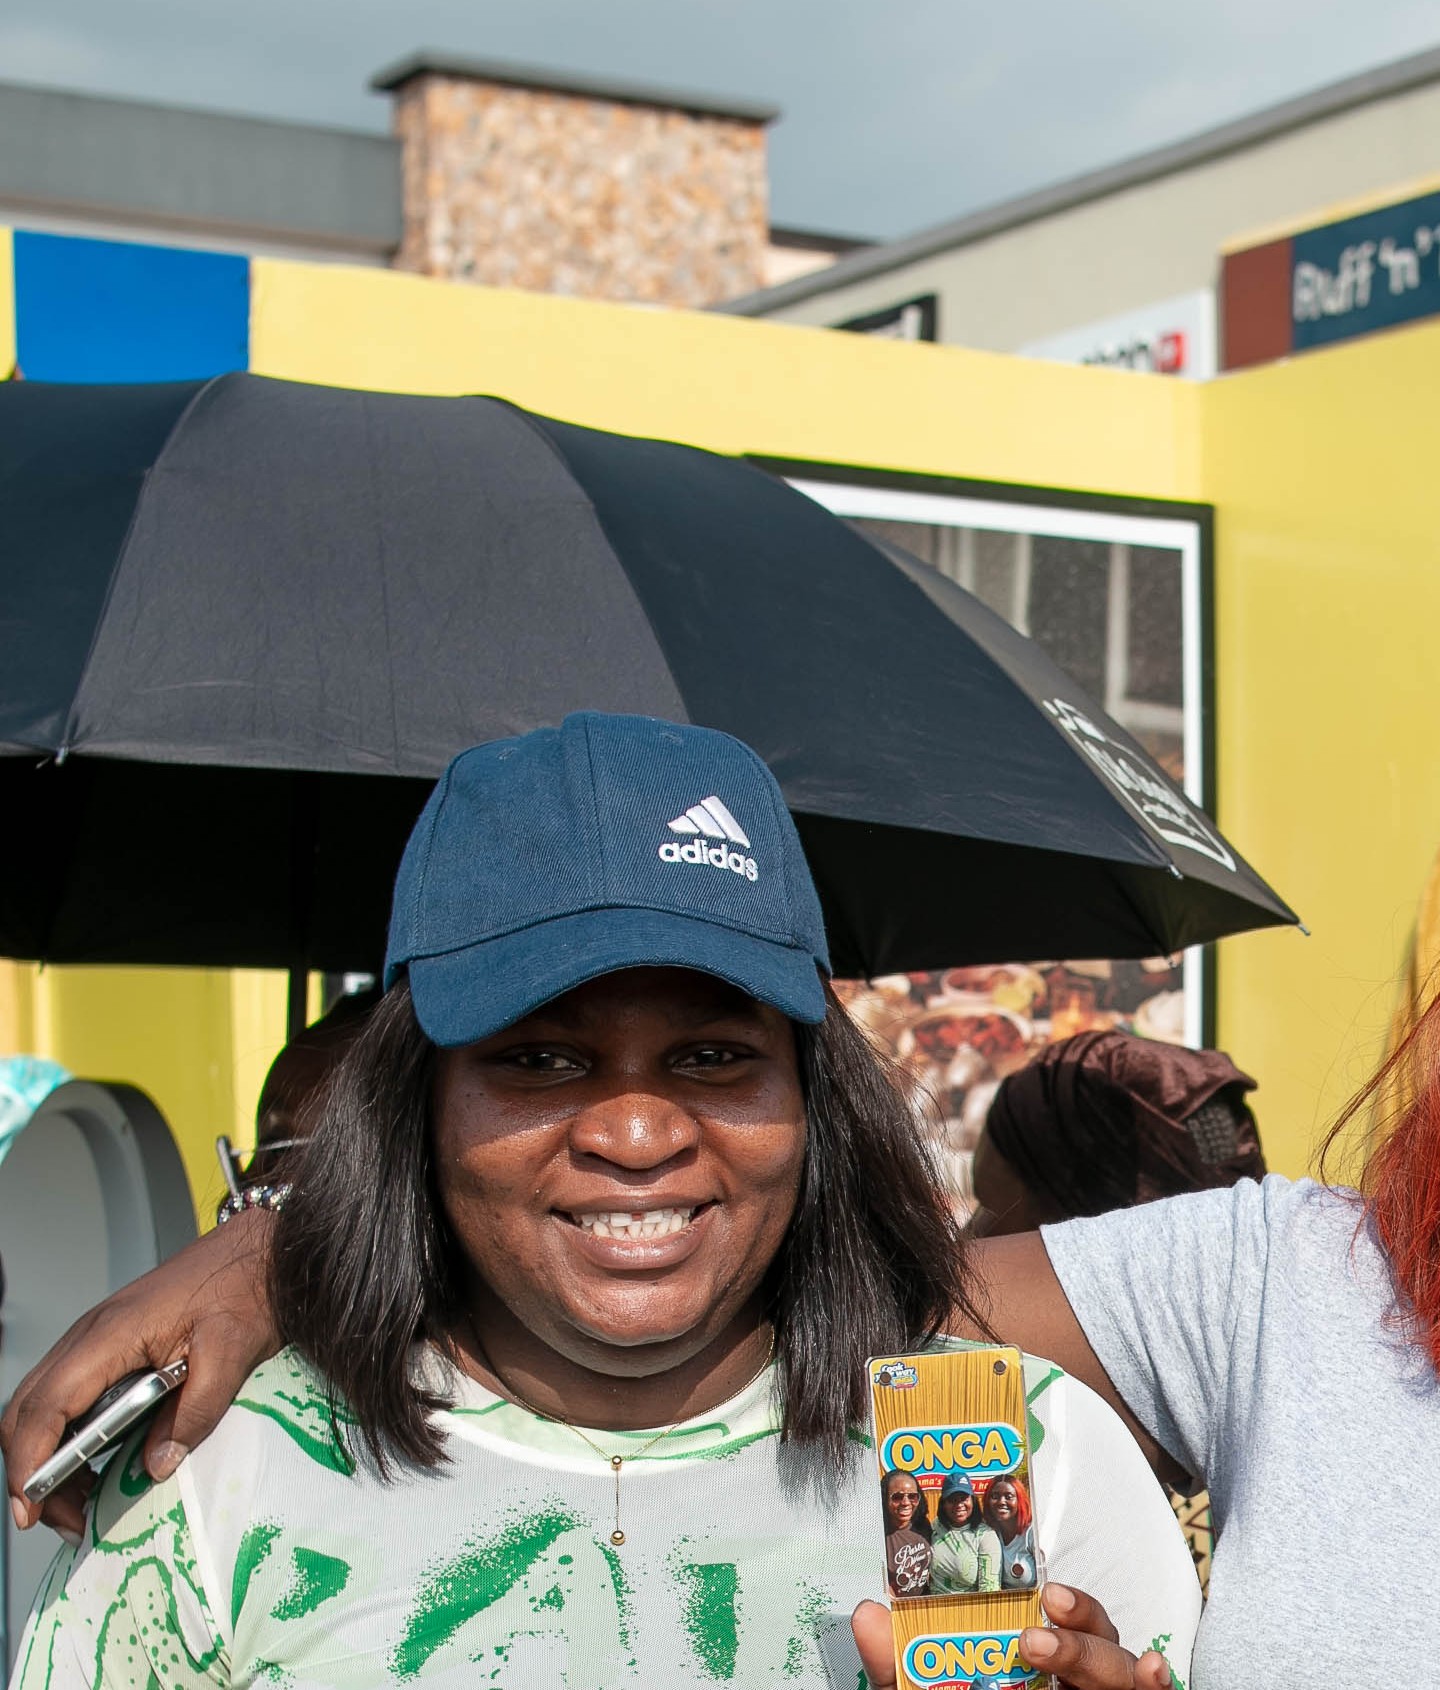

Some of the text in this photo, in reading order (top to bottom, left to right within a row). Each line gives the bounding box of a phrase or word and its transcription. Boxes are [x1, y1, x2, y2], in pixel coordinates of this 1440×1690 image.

[1293, 240, 1377, 323] Ruff
[658, 838, 759, 882] adidas
[891, 1429, 1011, 1472] ONGA
[913, 1637, 1032, 1679] ONGA
